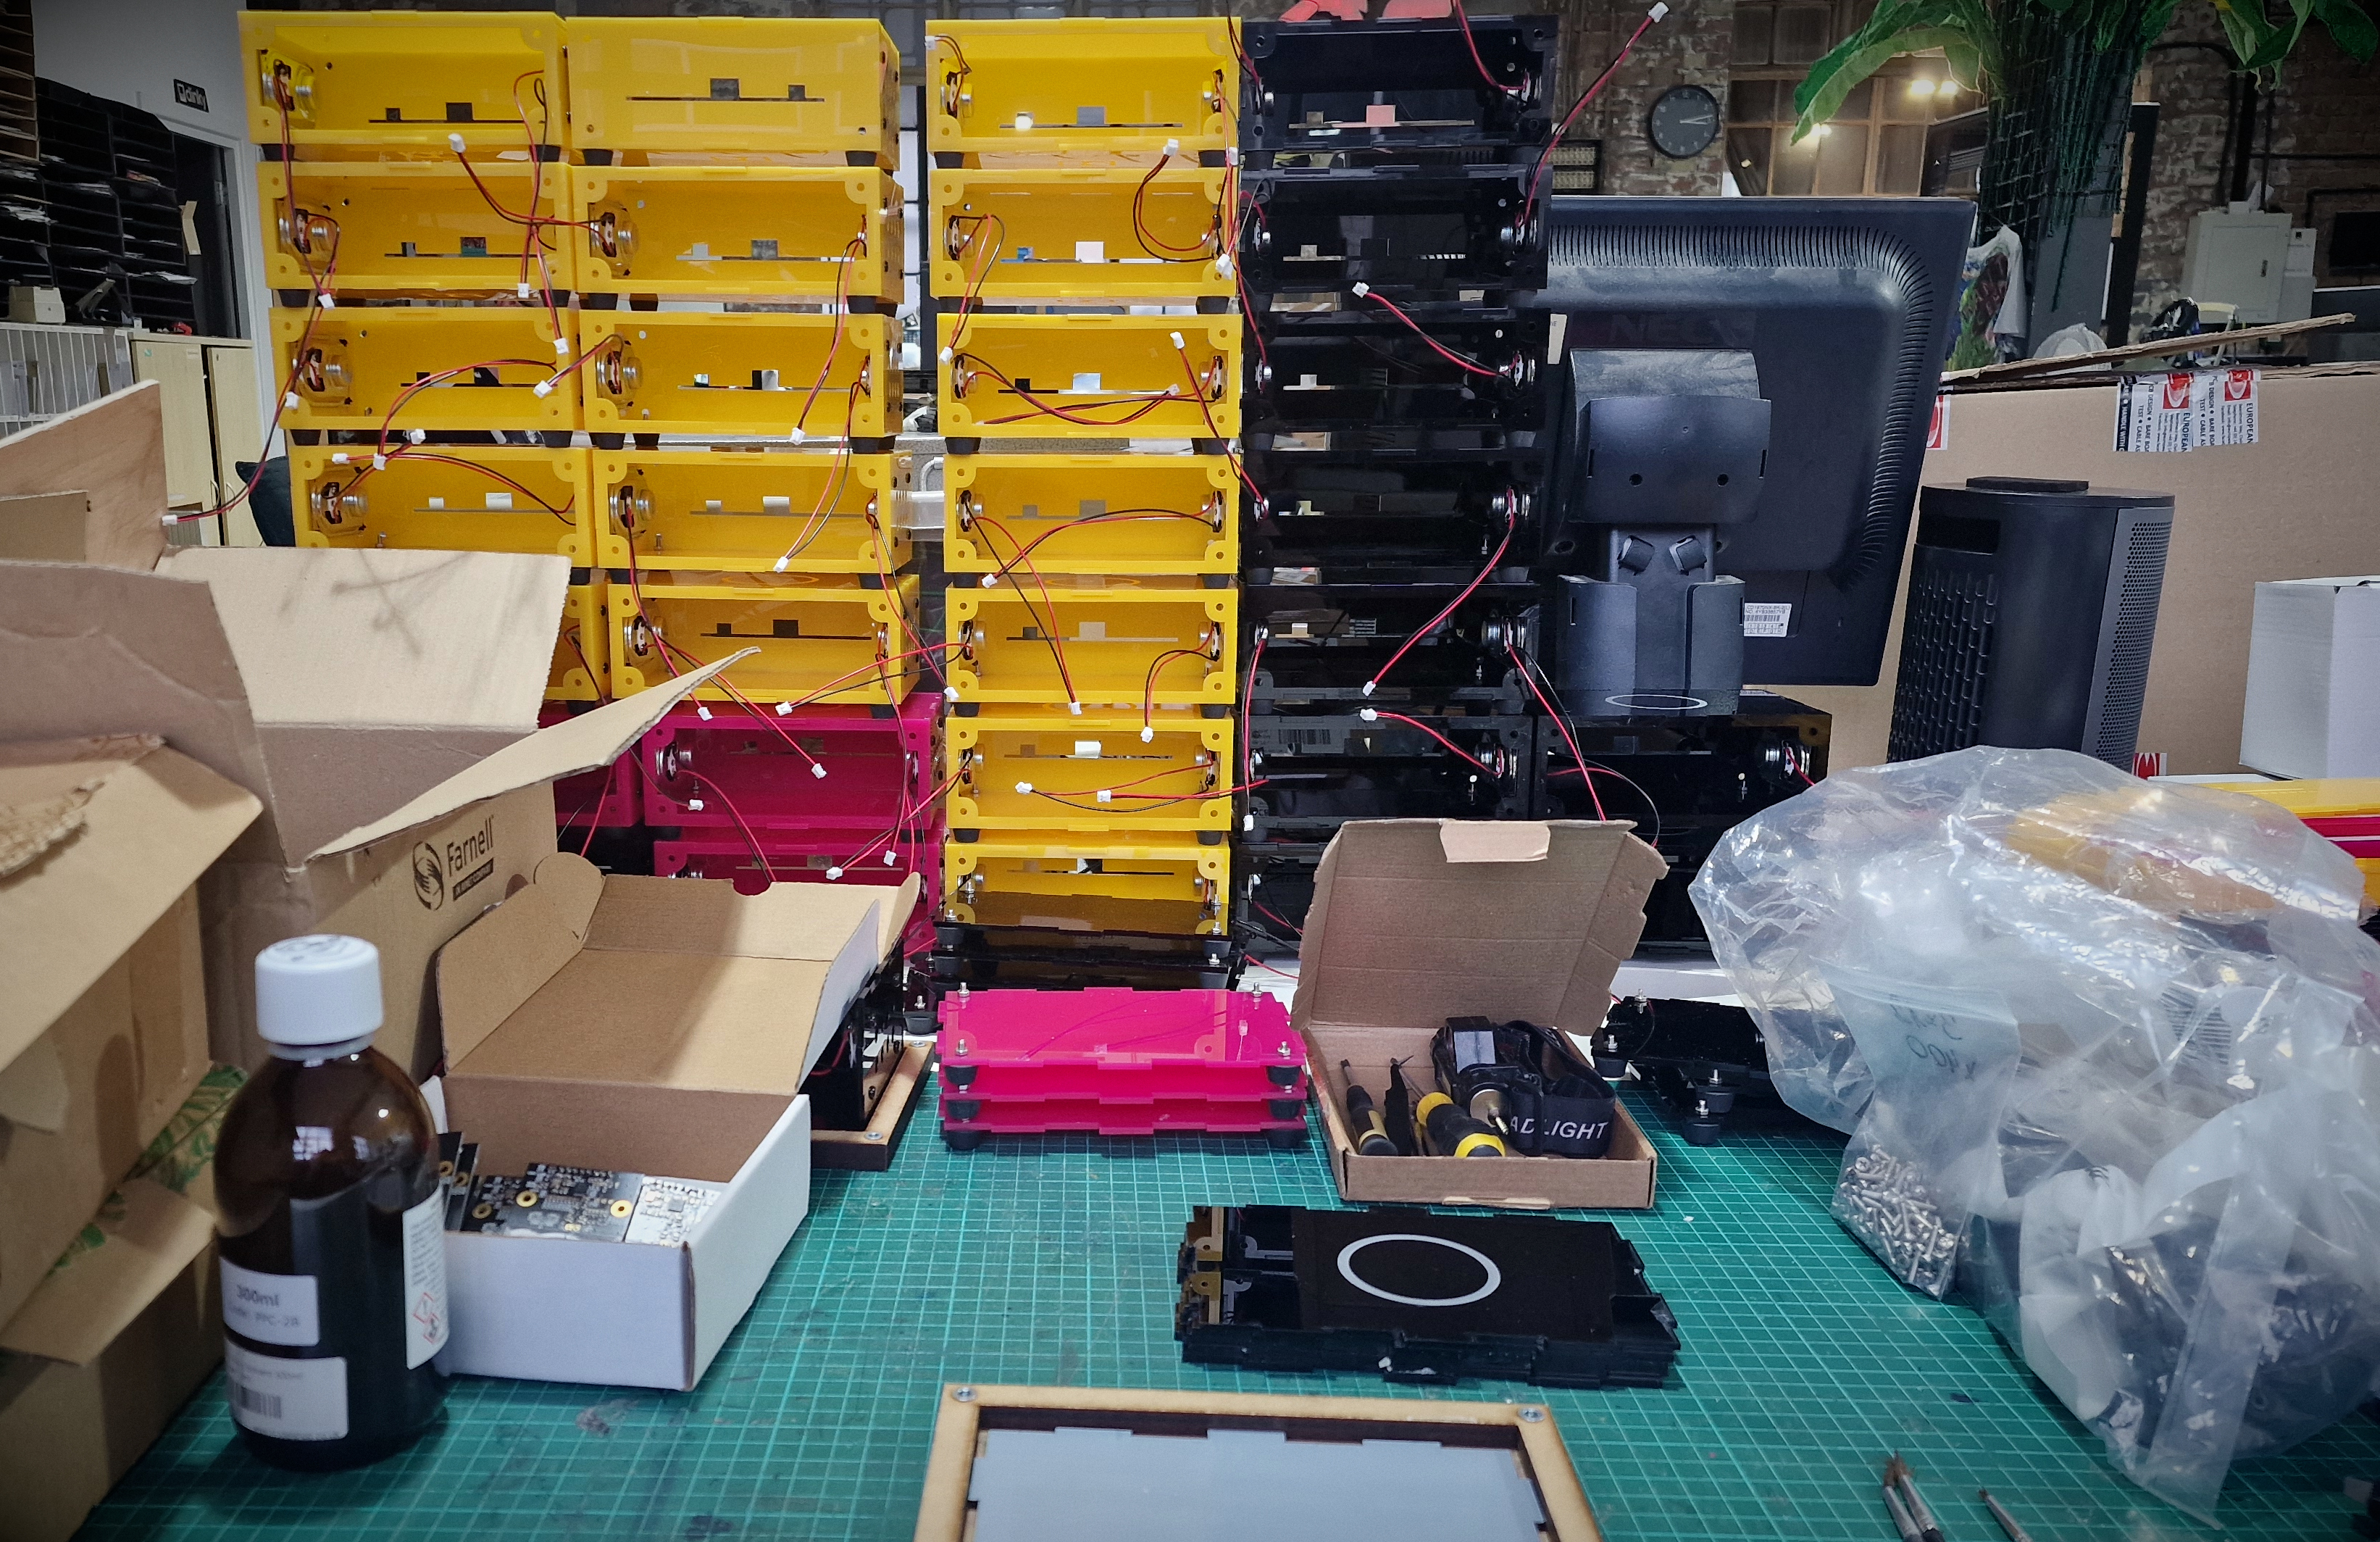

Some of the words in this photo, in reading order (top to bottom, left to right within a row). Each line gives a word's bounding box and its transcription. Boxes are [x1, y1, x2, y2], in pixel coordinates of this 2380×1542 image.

[2120, 407, 2129, 431] HANDLE
[2181, 412, 2191, 452] EUROPEAN
[2118, 430, 2127, 447] WITH
[446, 817, 493, 878] Farnell
